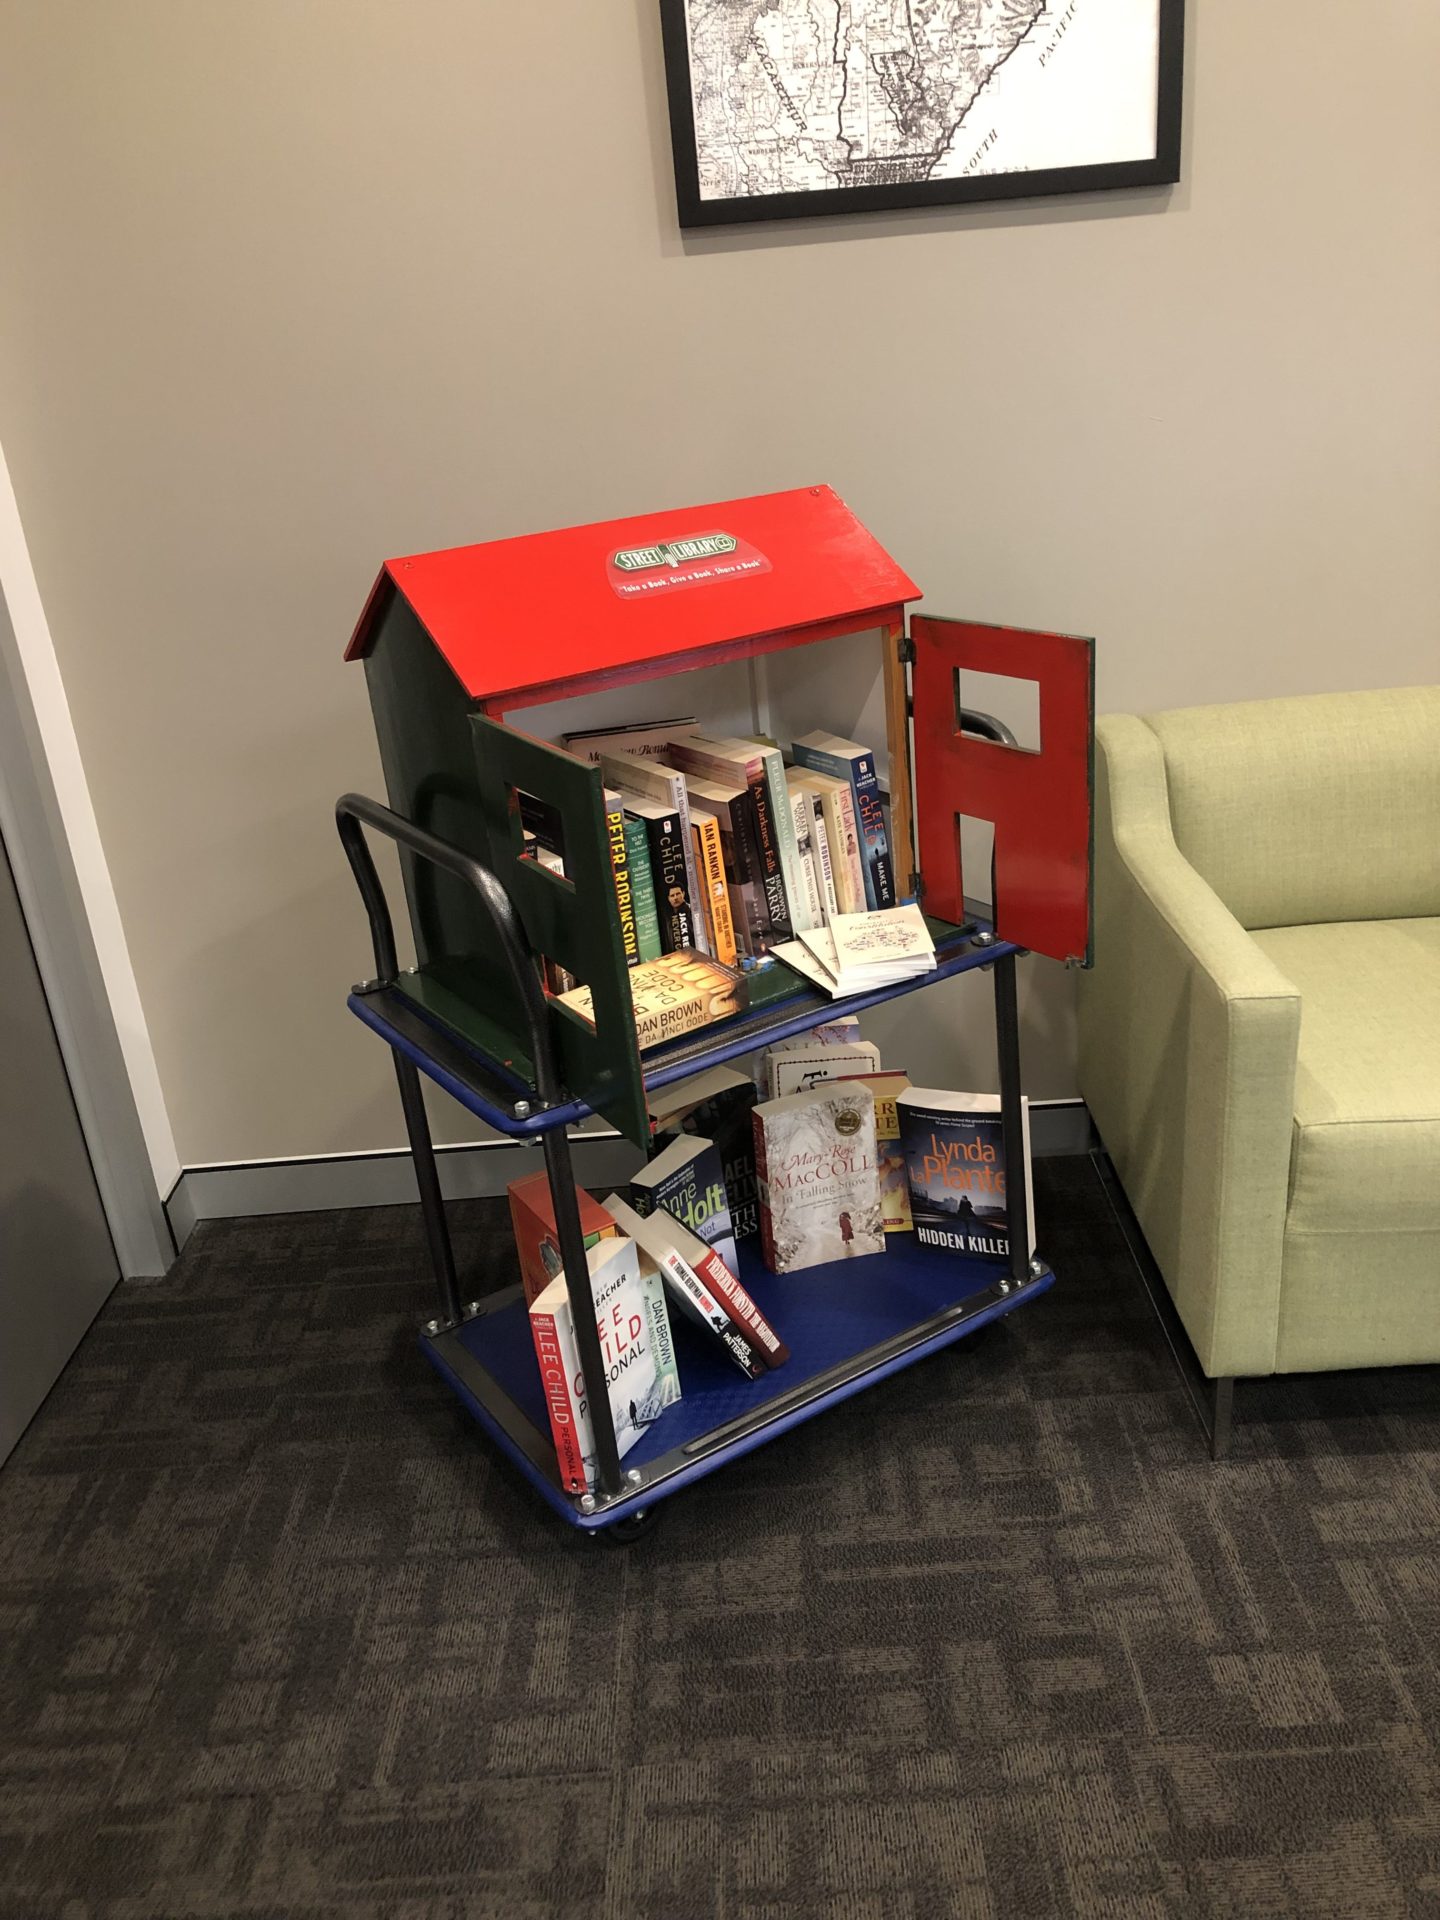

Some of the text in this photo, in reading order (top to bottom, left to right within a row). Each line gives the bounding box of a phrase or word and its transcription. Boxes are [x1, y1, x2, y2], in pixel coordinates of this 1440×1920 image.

[963, 128, 998, 175] SOUTH
[620, 538, 718, 568] STREET LIBRARY
[670, 574, 687, 584] Give
[715, 565, 736, 575] Share
[754, 786, 776, 873] As Darkness Falls
[859, 794, 877, 846] CHILD
[870, 800, 884, 831] LEE
[608, 812, 627, 864] PETER
[703, 823, 721, 881] IAN RANKIN
[660, 836, 675, 884] CHILD
[672, 843, 683, 871] LEE
[821, 845, 831, 880] ROBINSON
[775, 873, 787, 920] BRONWYN
[877, 861, 889, 901] MAKE ME
[615, 870, 637, 955] ROBINSON
[765, 878, 782, 923] PARRY
[672, 915, 681, 941] NEVER
[679, 912, 690, 949] JACK RE
[643, 969, 684, 992] CODE
[655, 991, 677, 1005] DA
[645, 1033, 657, 1044] DA
[661, 1023, 684, 1038] VINCI
[686, 1012, 708, 1027] CODE
[660, 999, 703, 1027] BROWN
[931, 1133, 996, 1165] Lynda
[782, 1194, 793, 1205] In
[795, 1182, 836, 1201] Falling
[837, 1177, 868, 1191] Snow
[910, 1155, 1007, 1196] La Plante
[656, 1182, 697, 1214] Anne
[675, 1183, 726, 1229] Holt
[731, 1204, 756, 1225] TH
[701, 1222, 716, 1237] Not
[734, 1217, 758, 1240] ESS
[917, 1227, 965, 1250] HIDDEN
[673, 1262, 689, 1281] THOMAS
[593, 1274, 627, 1310] EACHER
[597, 1303, 623, 1341] EE
[652, 1299, 672, 1366] DAN BROWN
[723, 1332, 751, 1367] PATTERSON
[733, 1334, 752, 1356] JAMES
[538, 1331, 570, 1424] LEE CHILD
[561, 1427, 577, 1475] PERSONAL
